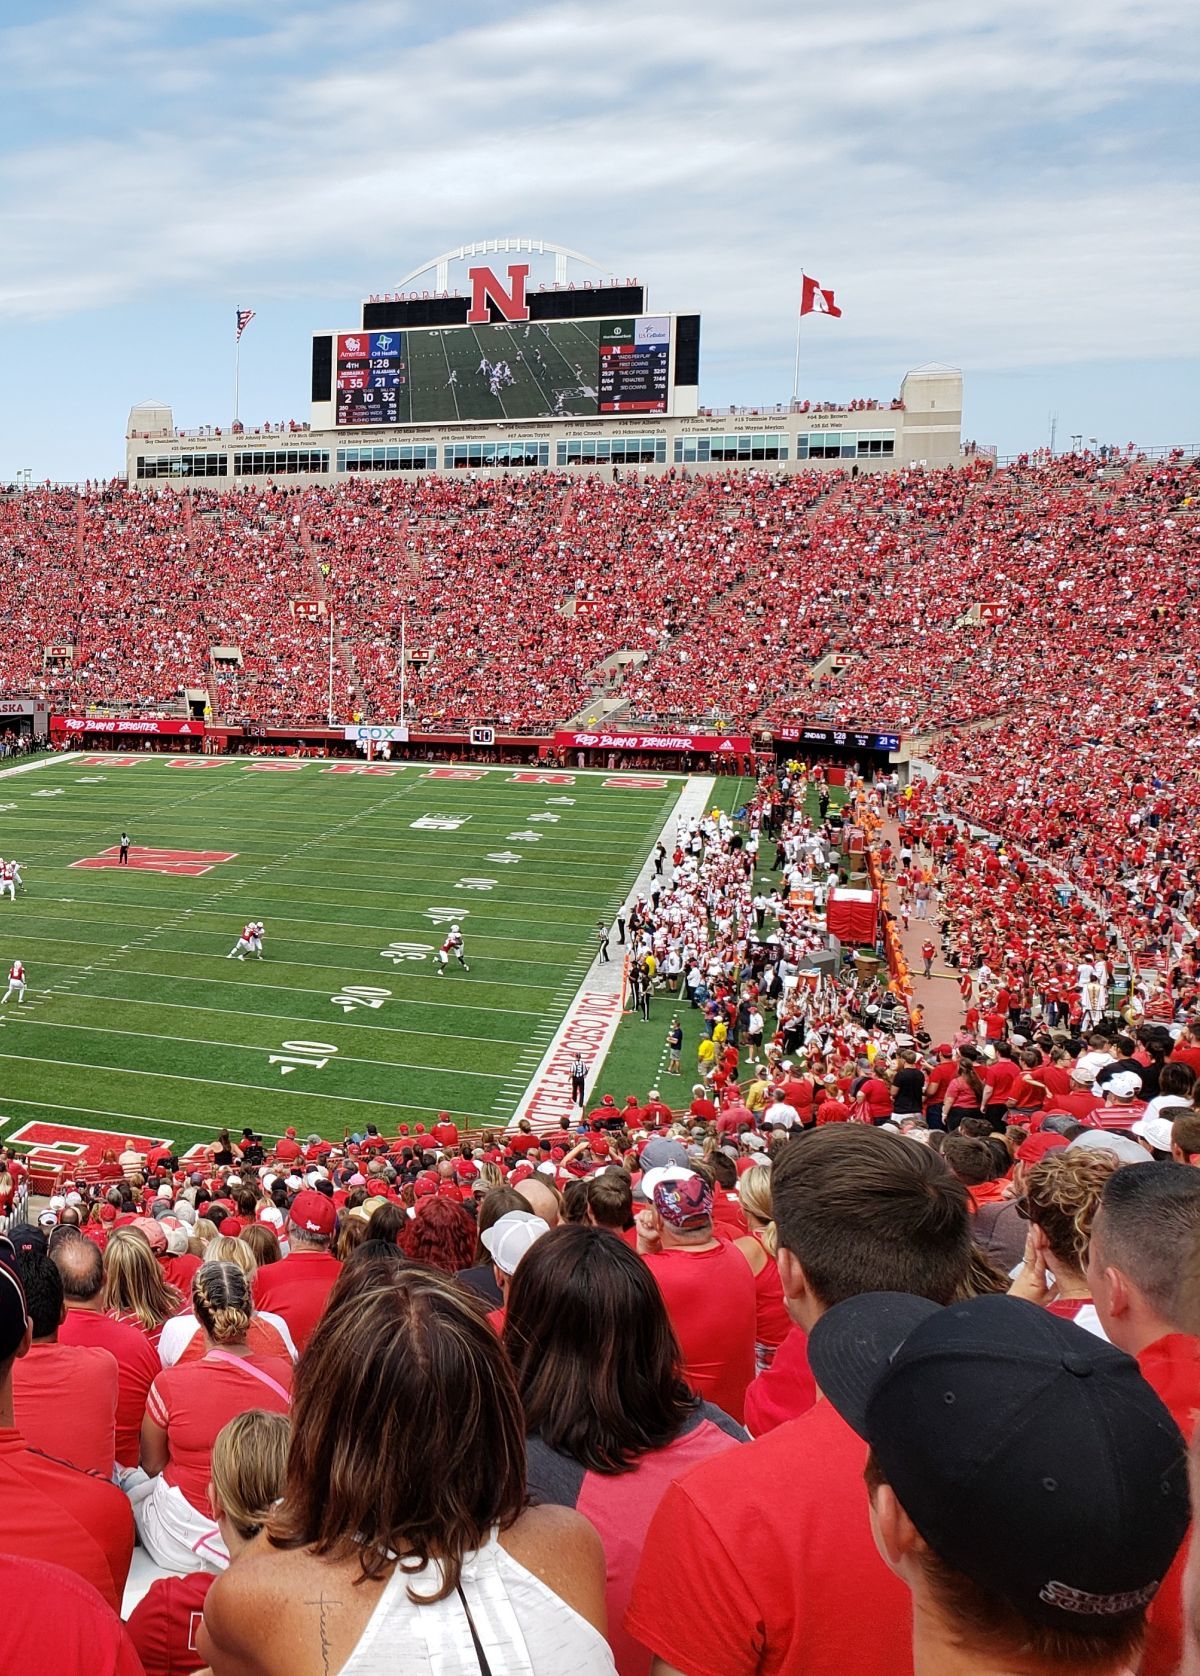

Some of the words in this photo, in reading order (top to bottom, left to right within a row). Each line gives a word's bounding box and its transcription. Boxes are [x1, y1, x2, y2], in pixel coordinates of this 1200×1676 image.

[369, 287, 461, 304] MEMORIAL
[539, 277, 638, 293] STADIUM
[466, 263, 531, 324] N
[612, 346, 621, 354] N
[369, 359, 390, 368] 1:28
[350, 379, 363, 388] 35
[375, 378, 385, 387] 21
[345, 395, 351, 403] 2
[363, 394, 373, 402] 10
[382, 393, 395, 401] 32
[36, 703, 45, 712] N
[64, 718, 84, 730] RED
[117, 719, 160, 733] BRIGHTER
[358, 728, 395, 739] COX
[474, 730, 491, 742] 40
[789, 729, 799, 737] 35
[573, 734, 599, 745] RED
[600, 735, 636, 748] BURNS
[639, 737, 694, 749] BRIGHTER
[880, 737, 888, 745] 21
[68, 756, 668, 789] HUSKERS
[453, 877, 499, 892] 50
[379, 942, 435, 961] 30
[331, 985, 393, 1008] 20
[576, 992, 620, 1018] TOM
[269, 1040, 339, 1069] 10
